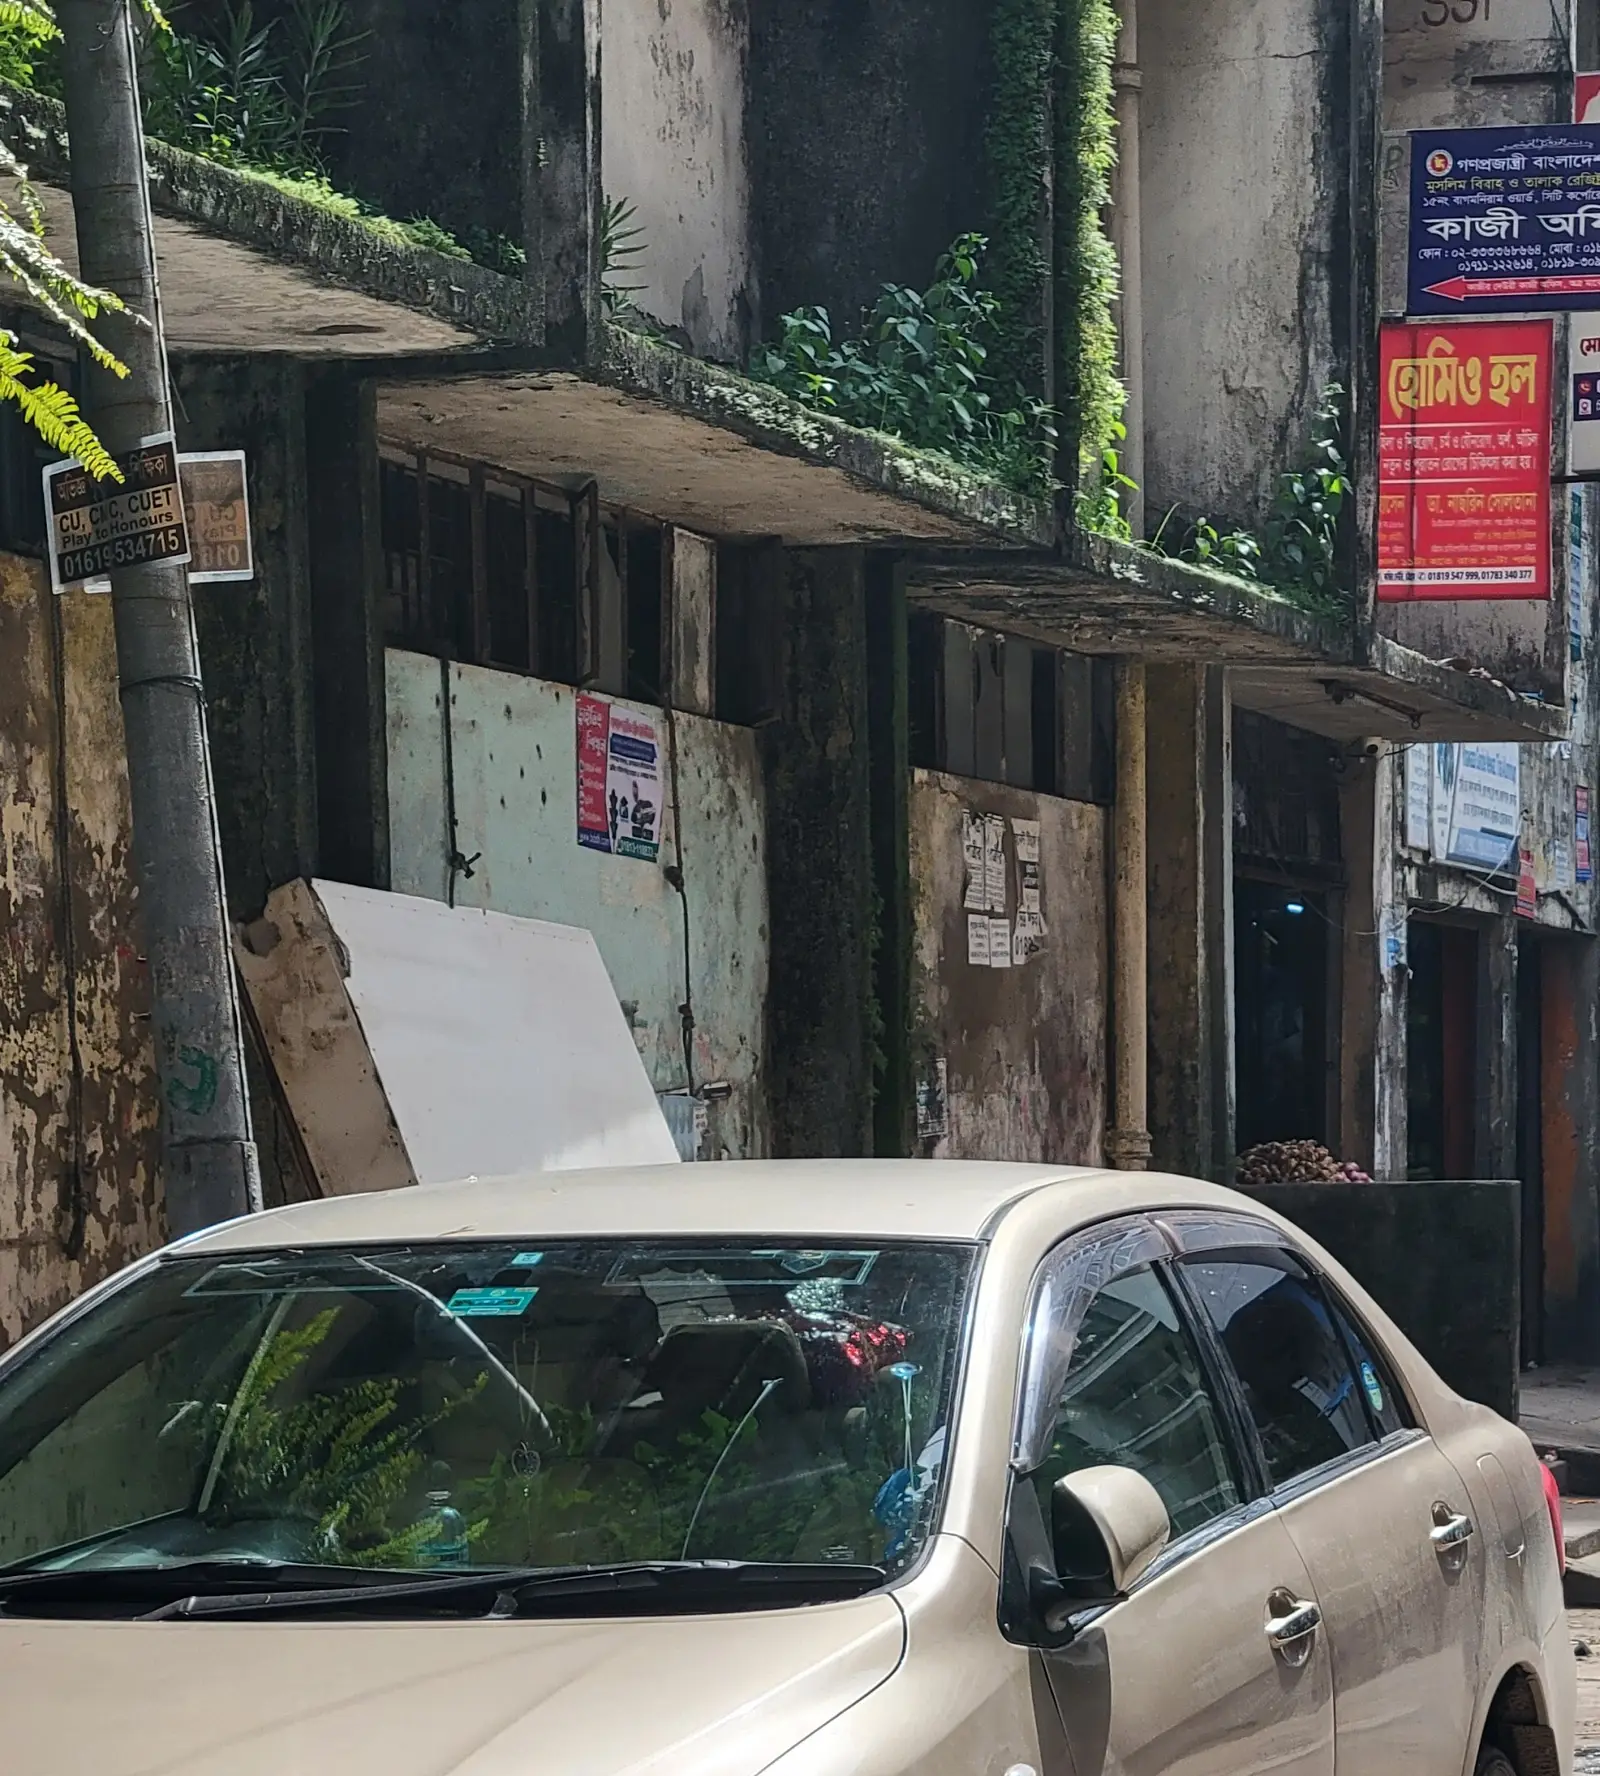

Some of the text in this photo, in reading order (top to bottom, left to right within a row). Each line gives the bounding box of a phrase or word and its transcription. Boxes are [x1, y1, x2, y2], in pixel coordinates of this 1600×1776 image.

[1426, 177, 1466, 193] মুসলিম
[1508, 178, 1519, 188] ও
[1524, 176, 1564, 188] তালাক
[1422, 207, 1528, 241] কাজী
[1418, 247, 1442, 260] ফোন
[1388, 336, 1482, 419] হোমিও
[1489, 354, 1537, 407] হল
[59, 512, 86, 534] CU,
[128, 487, 173, 514] CUET
[62, 532, 92, 550] Play
[110, 512, 174, 536] Honours
